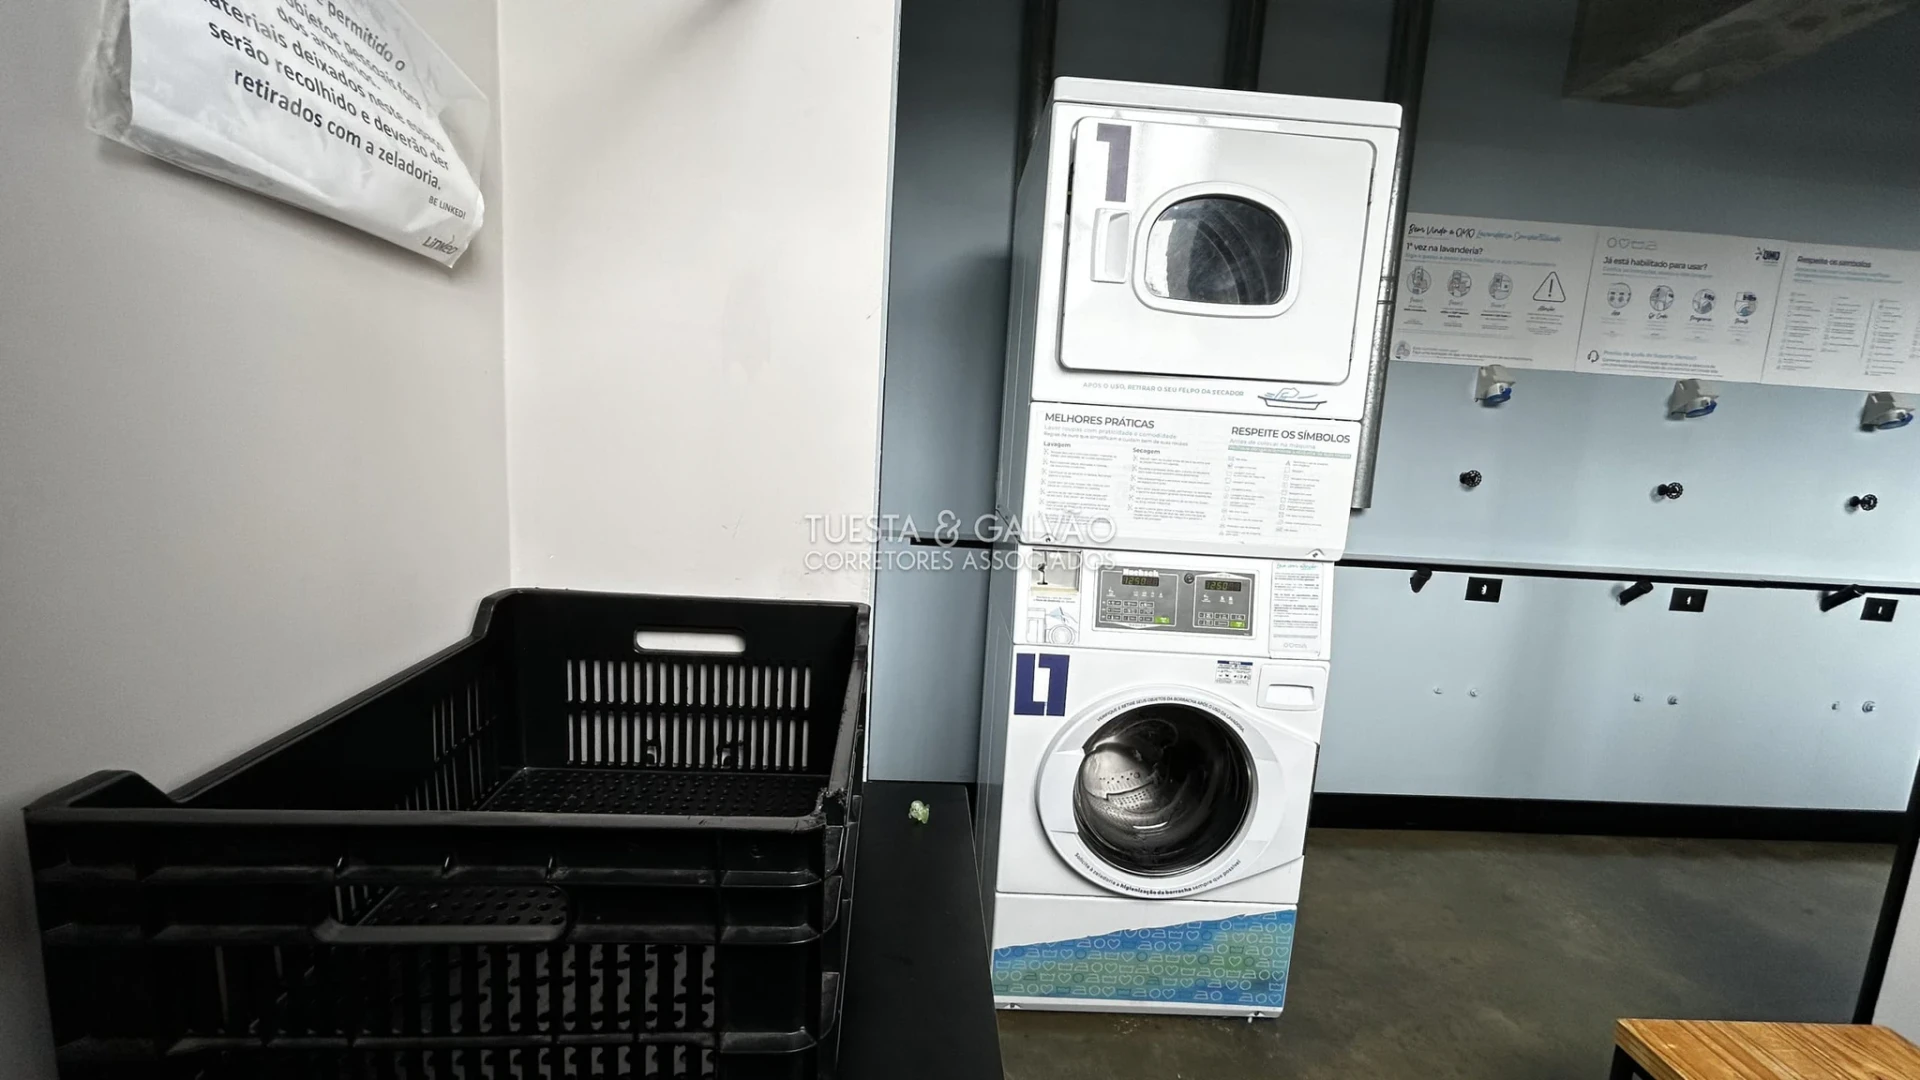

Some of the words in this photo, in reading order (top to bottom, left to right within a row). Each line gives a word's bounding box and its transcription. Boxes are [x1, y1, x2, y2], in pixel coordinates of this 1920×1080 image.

[276, 6, 309, 37] dos
[328, 1, 393, 62] permitido
[395, 60, 406, 71] o
[204, 0, 288, 48] ateriais
[292, 41, 366, 97] deixados
[368, 91, 405, 124] neste
[208, 21, 269, 66] serão
[275, 58, 357, 116] recolhido
[361, 110, 371, 124] e
[374, 116, 428, 158] deverão
[234, 69, 323, 128] retirados
[327, 120, 361, 149] com
[365, 140, 375, 155] a
[378, 147, 441, 191] zeladoria.
[428, 195, 438, 206] BE
[439, 200, 467, 220] LINKED!
[1407, 224, 1426, 235] Bem
[1426, 225, 1448, 236] Vindo
[1455, 227, 1476, 239] OMO
[1439, 244, 1484, 255] lavanderia?
[1603, 256, 1612, 265] Já
[1613, 257, 1629, 265] está
[1630, 258, 1668, 268] habilitado
[1668, 262, 1686, 270] para
[1687, 262, 1708, 271] usar?
[1082, 381, 1102, 389] APÓS
[1127, 384, 1156, 392] RETIRAR
[1212, 389, 1245, 397] SECADOR
[1044, 412, 1103, 425] MELHORES
[1104, 416, 1155, 429] PRÁTICAS
[1098, 428, 1133, 437] praticidade
[1231, 426, 1280, 438] RESPEITE
[1281, 430, 1296, 440] OS
[1297, 430, 1351, 444] SÍMBOLOS
[1096, 707, 1118, 722] VERIFIQUE
[1121, 701, 1136, 709] RETIRE
[1174, 696, 1197, 704] BORRACHA
[1197, 700, 1208, 708] APÓS
[1212, 706, 1221, 714] USO
[1226, 714, 1245, 733] LAVADORA
[1093, 870, 1116, 885] zeladoria
[1119, 883, 1157, 896] higienização
[1165, 886, 1192, 895] borracha
[1192, 879, 1213, 891] sempre
[1213, 874, 1223, 882] que
